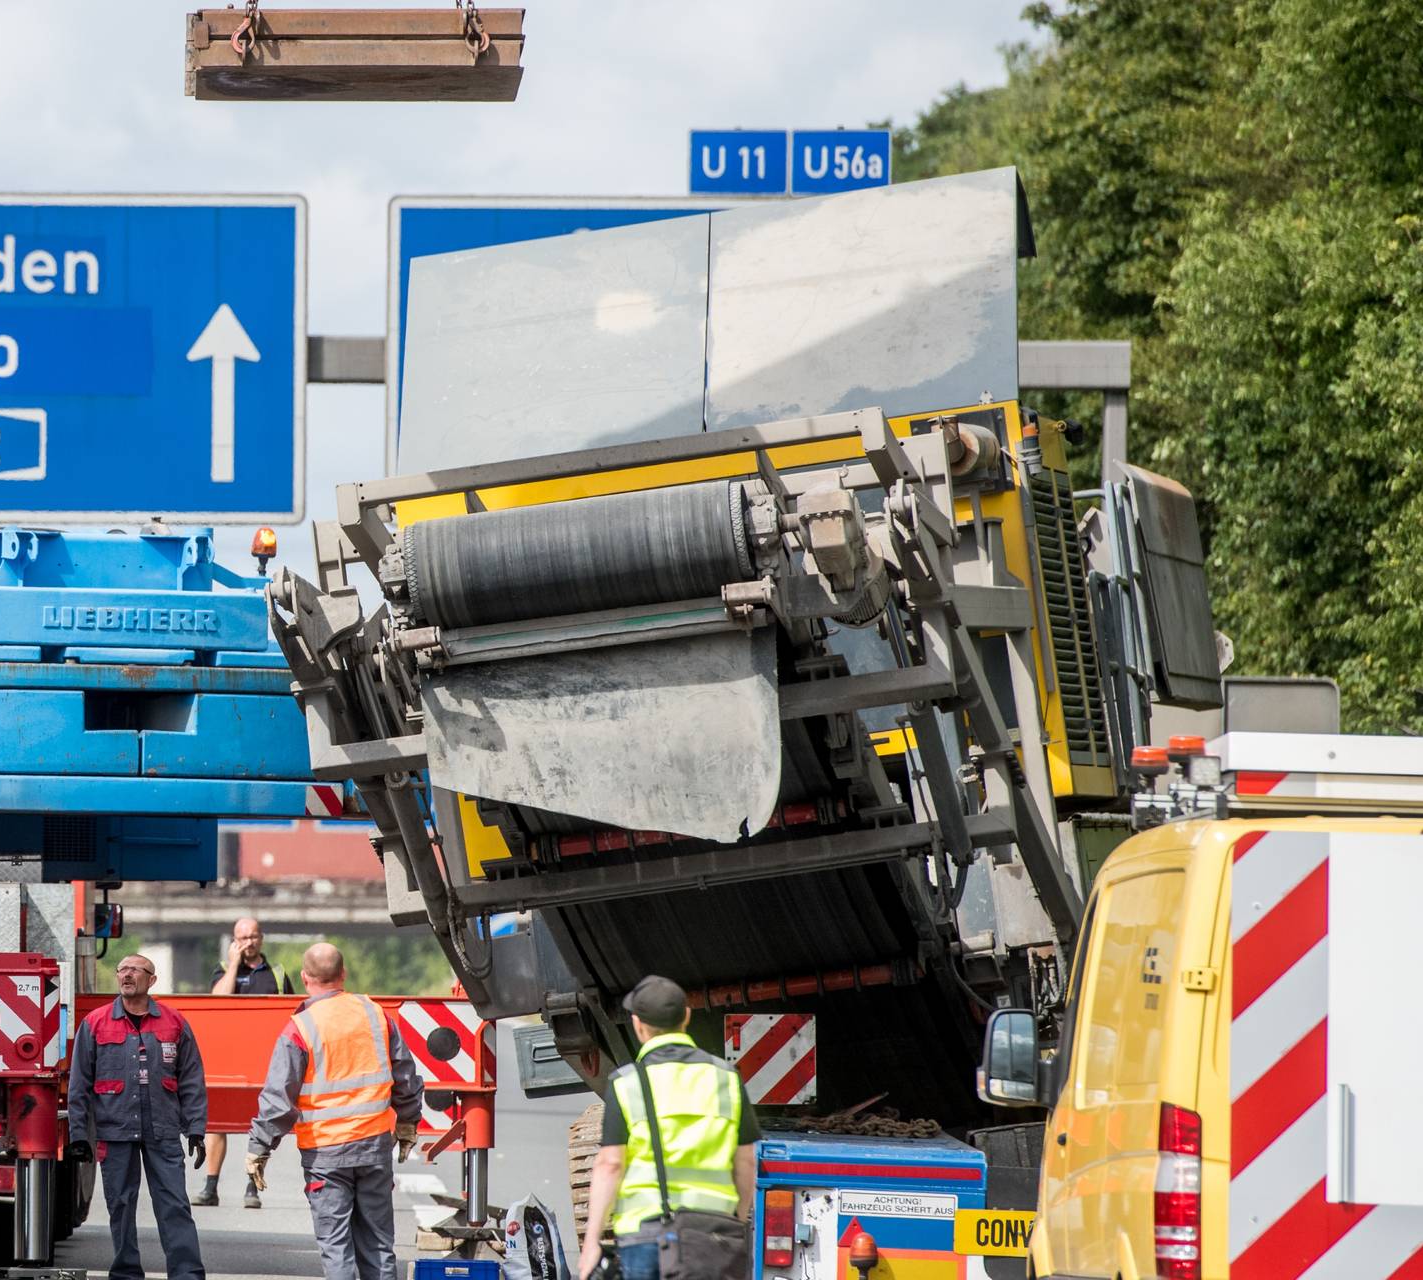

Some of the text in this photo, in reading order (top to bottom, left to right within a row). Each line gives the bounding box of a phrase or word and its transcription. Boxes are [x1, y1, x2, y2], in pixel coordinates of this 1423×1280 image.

[702, 145, 766, 179] U 11
[804, 145, 883, 179] U 56a
[43, 606, 219, 633] LIEBHERR
[18, 983, 30, 992] 2,7
[842, 1203, 954, 1215] FAHRZEUG SCHERT AUS
[873, 1196, 922, 1205] ACHTUNG!
